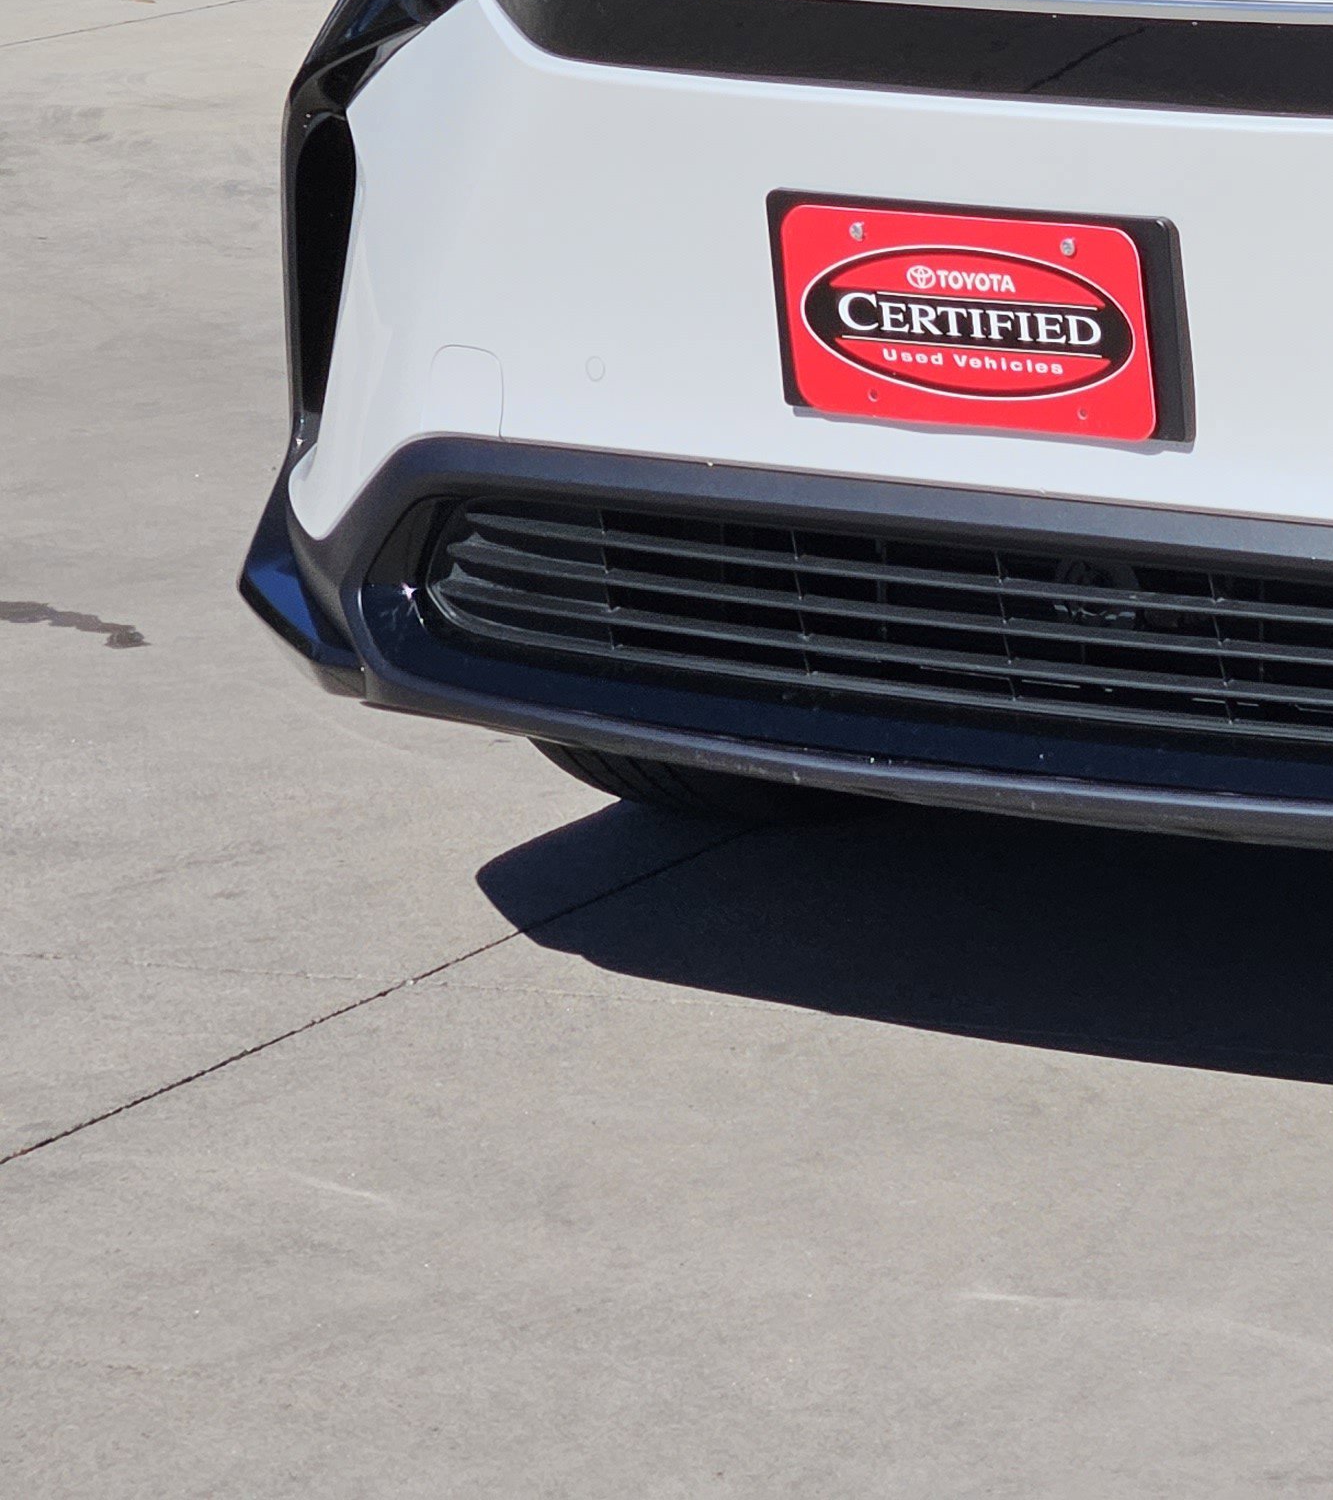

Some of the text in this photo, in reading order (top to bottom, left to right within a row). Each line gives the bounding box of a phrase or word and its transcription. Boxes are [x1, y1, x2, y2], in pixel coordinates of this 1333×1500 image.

[936, 271, 1016, 293] TOYOTA
[837, 292, 1102, 347] CERTIFIED
[883, 347, 1064, 375] Used Vehicles
